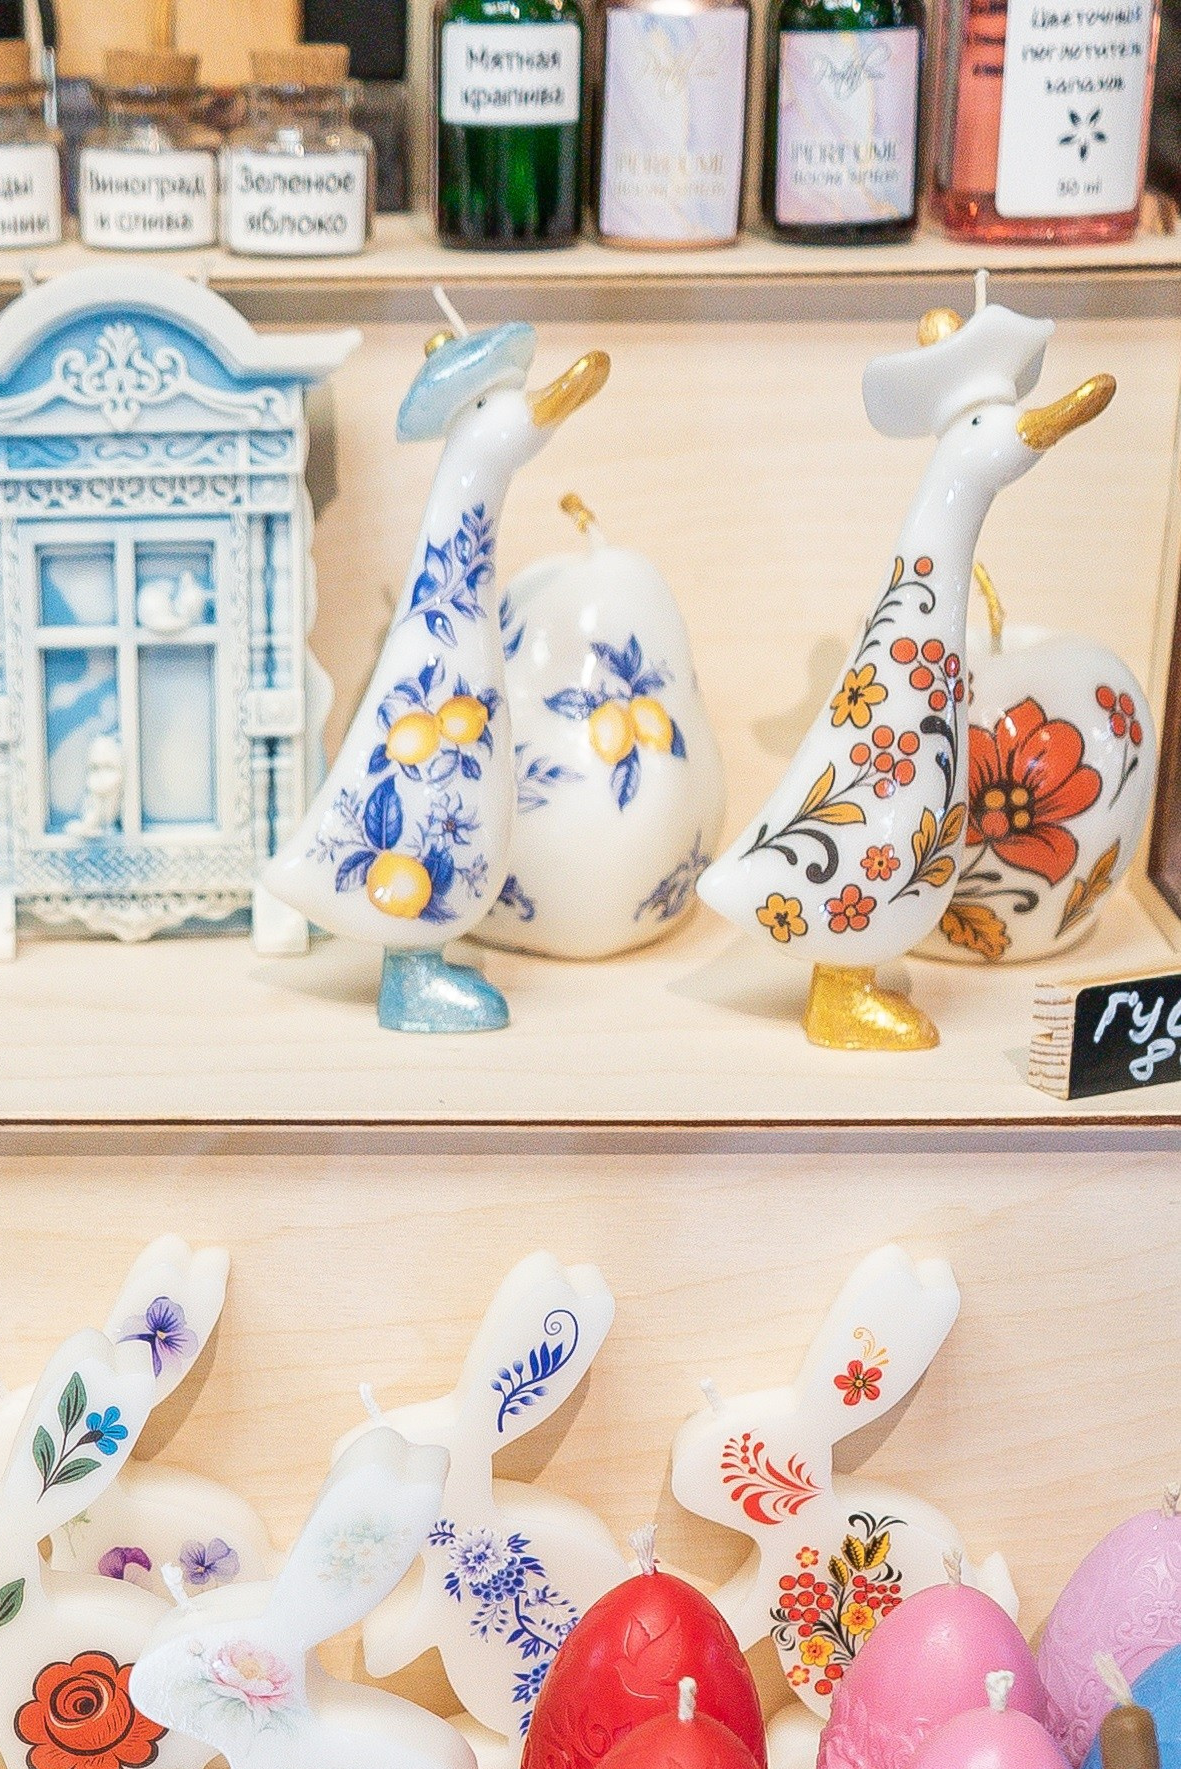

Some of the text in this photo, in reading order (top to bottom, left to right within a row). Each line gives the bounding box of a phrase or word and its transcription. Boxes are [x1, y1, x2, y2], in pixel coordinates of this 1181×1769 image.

[466, 46, 562, 73] Мятная
[460, 85, 566, 112] крапива
[88, 170, 207, 200] Виноград
[238, 163, 356, 195] Зеленое
[246, 205, 349, 235] яблоко
